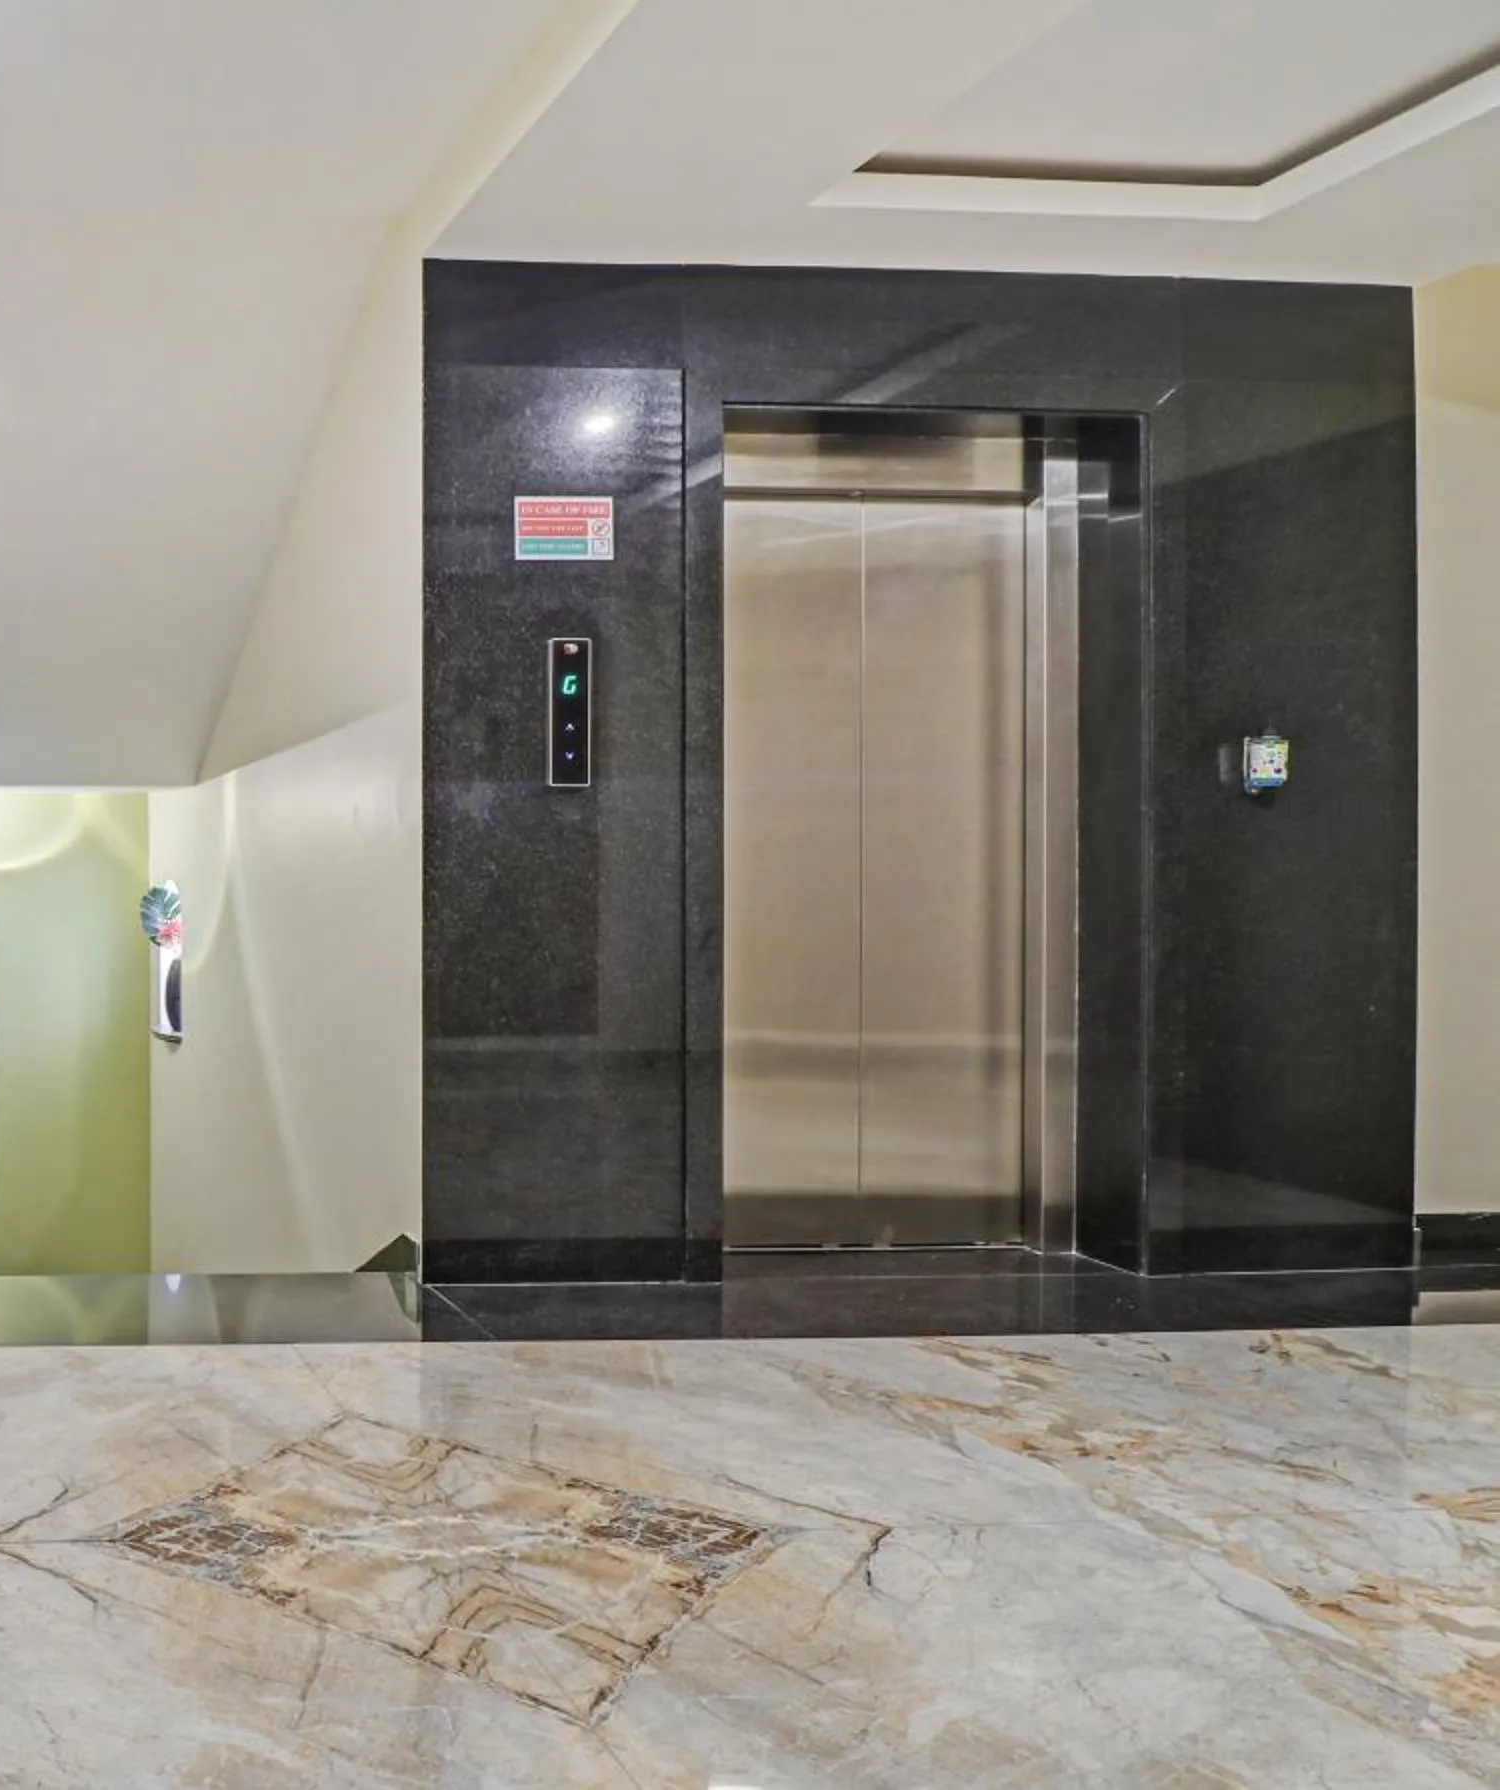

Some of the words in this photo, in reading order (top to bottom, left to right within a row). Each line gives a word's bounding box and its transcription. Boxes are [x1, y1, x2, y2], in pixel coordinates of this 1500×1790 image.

[521, 503, 533, 514] IN
[535, 503, 563, 514] CASE
[565, 503, 580, 514] OF
[562, 675, 577, 695] G
